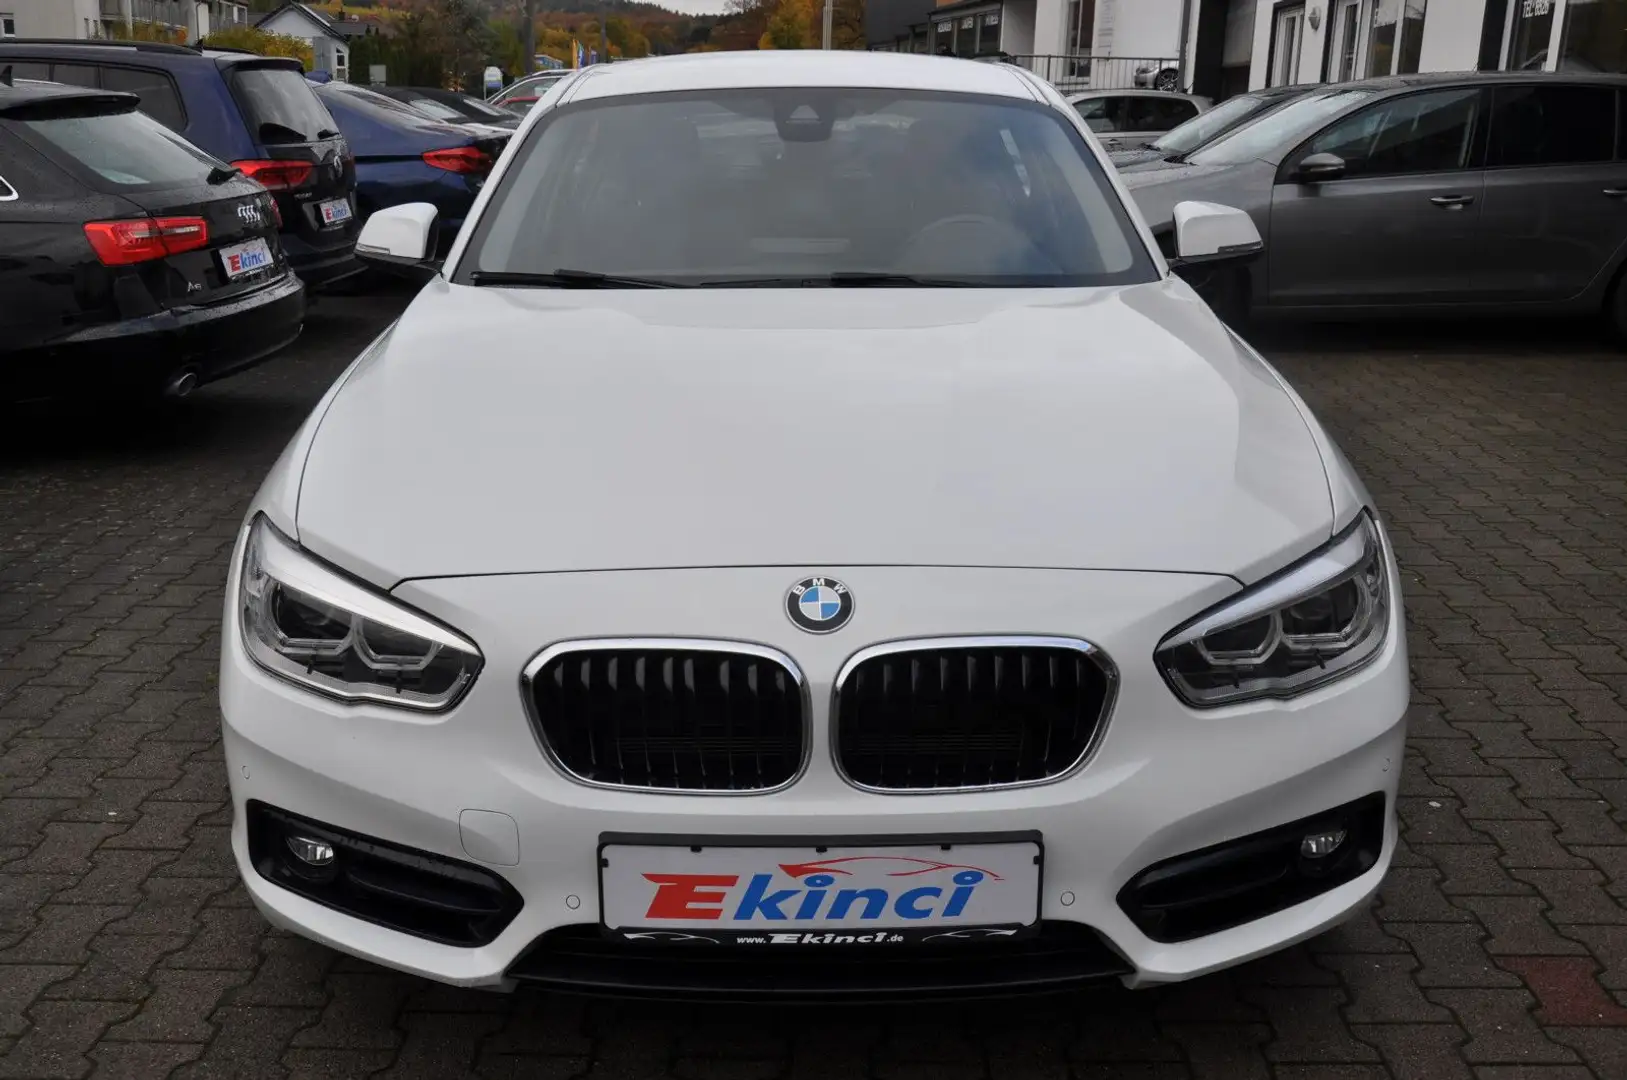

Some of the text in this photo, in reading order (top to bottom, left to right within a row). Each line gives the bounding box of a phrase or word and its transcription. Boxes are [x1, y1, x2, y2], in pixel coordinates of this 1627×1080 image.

[227, 251, 266, 273] Ekinci
[792, 578, 847, 595] BMW
[641, 870, 984, 921] Ekinci
